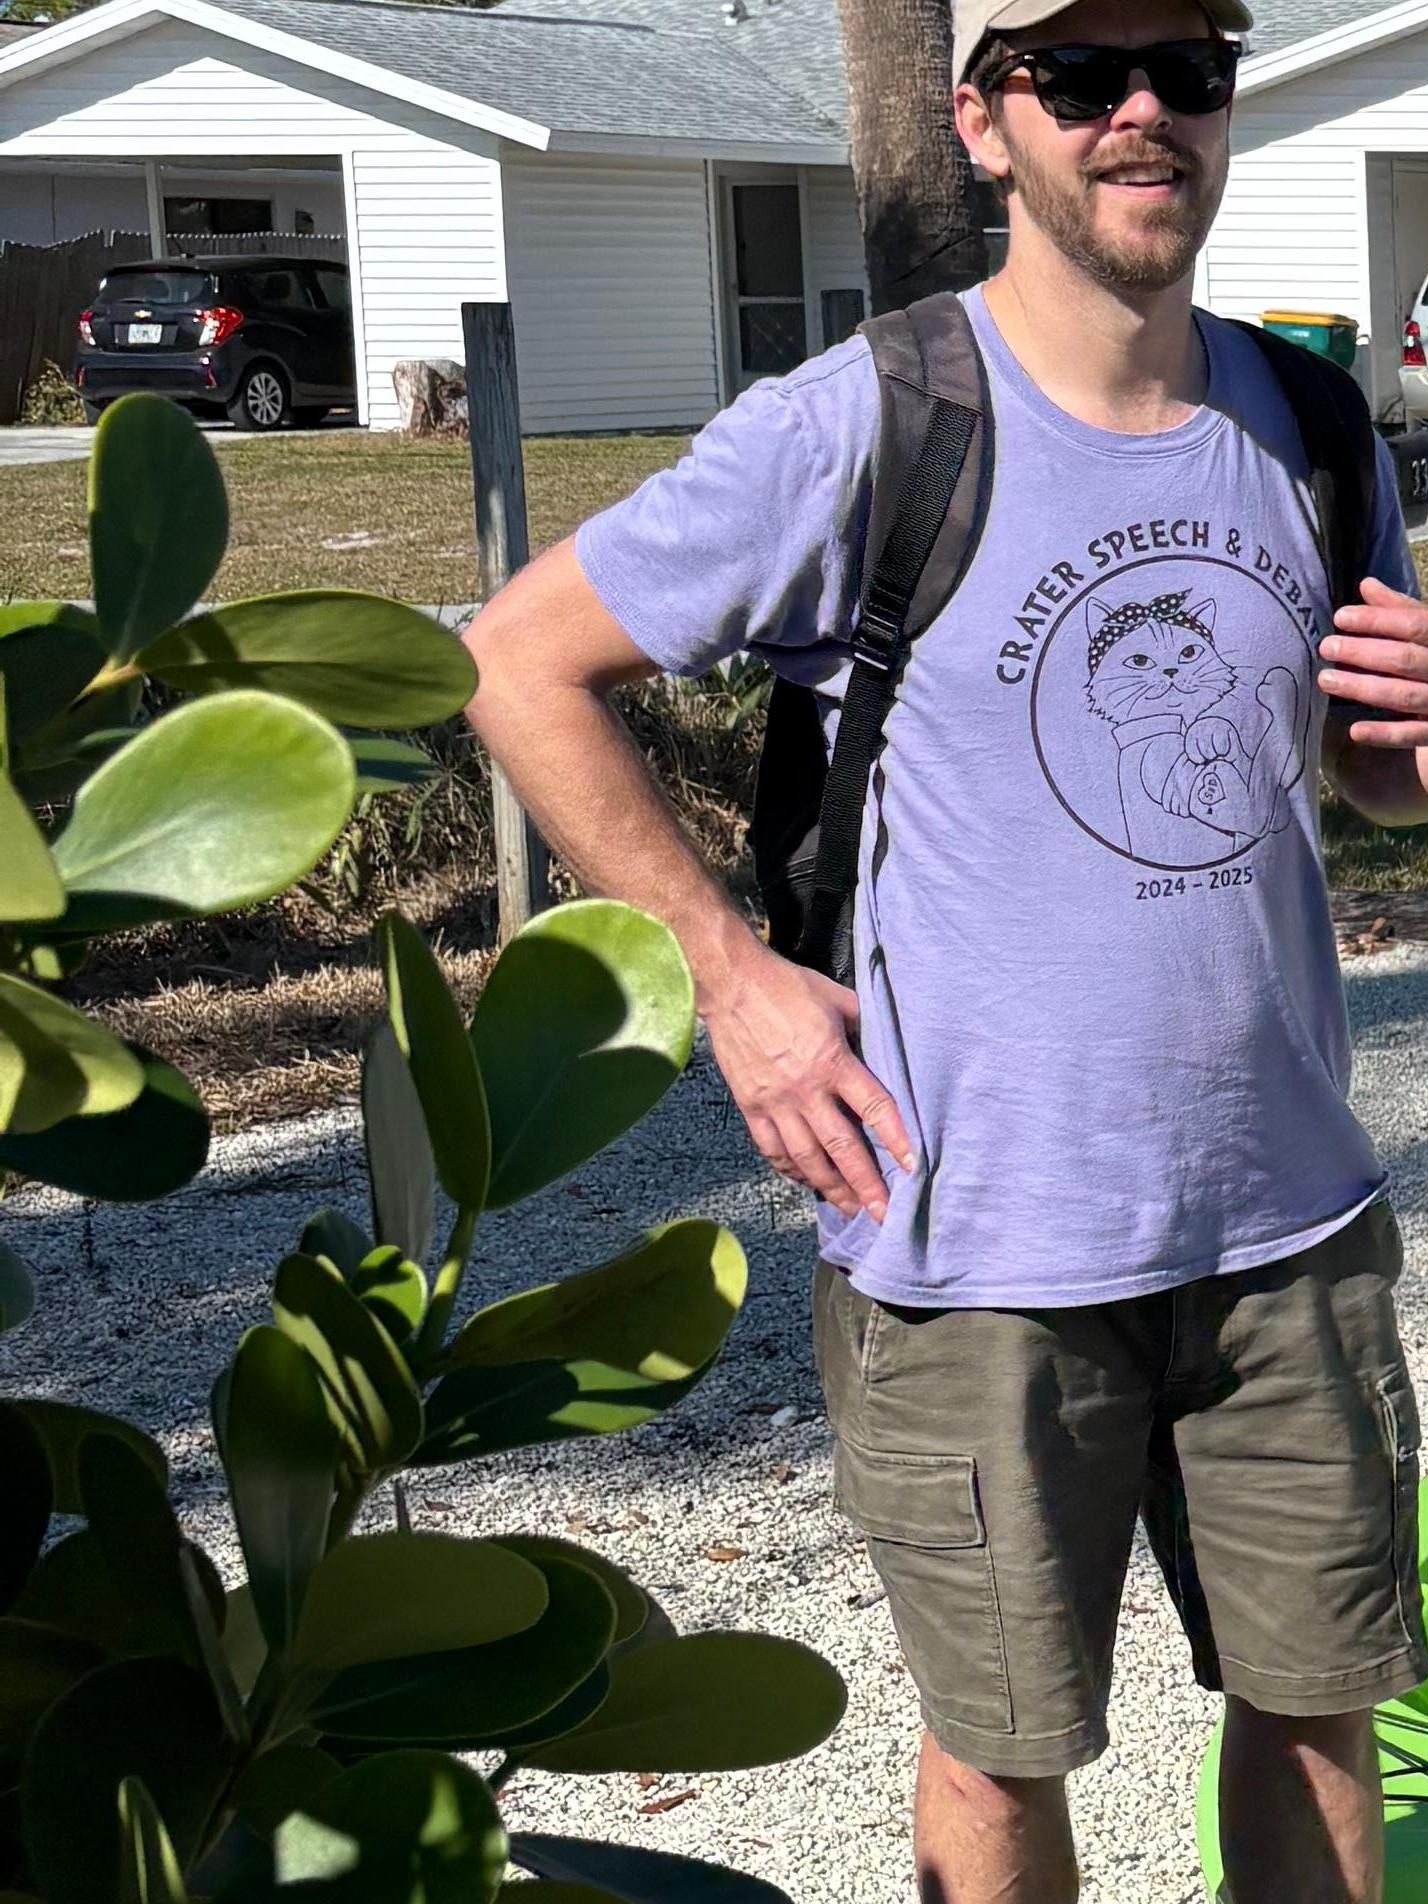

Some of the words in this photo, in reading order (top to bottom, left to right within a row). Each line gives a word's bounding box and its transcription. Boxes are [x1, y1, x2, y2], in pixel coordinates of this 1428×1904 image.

[996, 560, 1085, 684] CRATER
[1087, 519, 1210, 570] SPEECH
[1225, 527, 1241, 558] &
[1253, 544, 1321, 637] DEBAT
[1135, 876, 1187, 900] 2024
[1208, 865, 1253, 889] 2025
